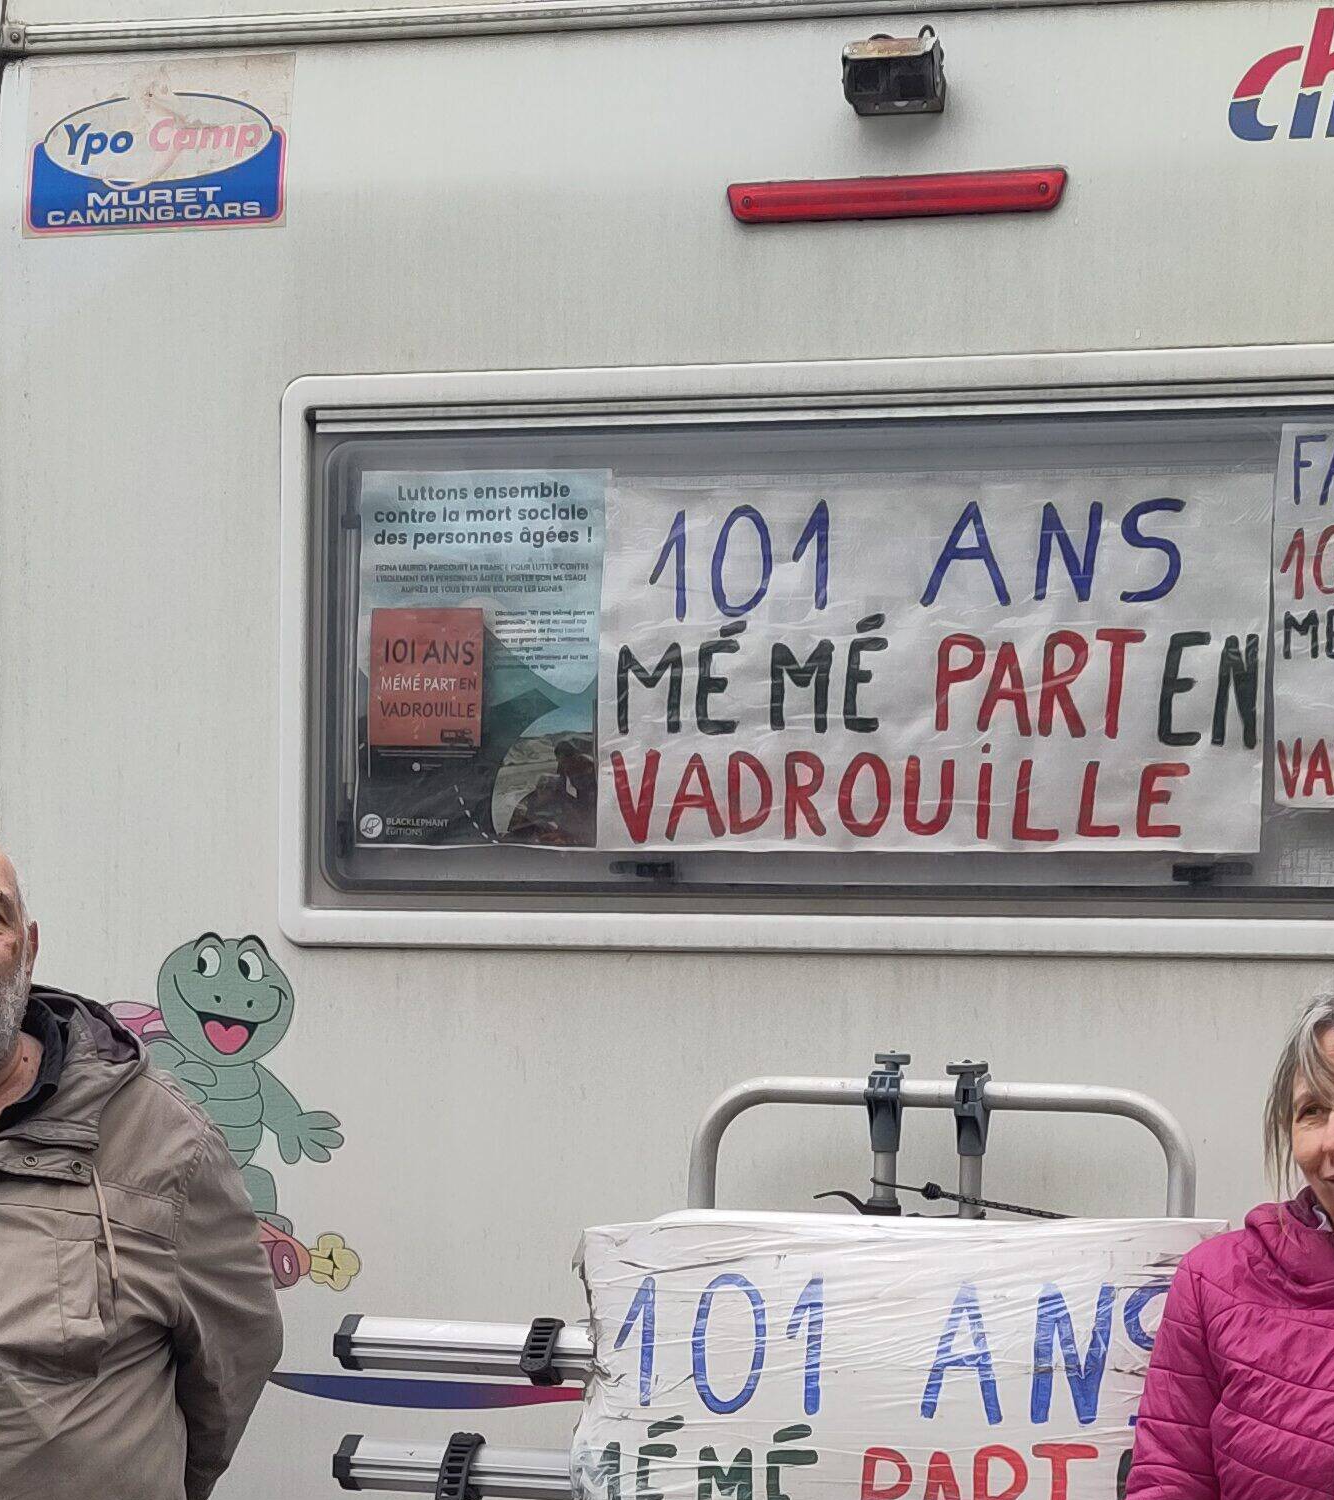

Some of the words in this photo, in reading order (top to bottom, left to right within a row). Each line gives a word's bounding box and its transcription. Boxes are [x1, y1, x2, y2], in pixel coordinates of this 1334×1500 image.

[64, 122, 134, 165] Ypo
[149, 117, 264, 157] Camp
[87, 186, 221, 207] MURET
[47, 202, 261, 226] CAMPING-CARS
[397, 485, 468, 502] Luttons
[473, 481, 571, 499] ensemble
[373, 506, 437, 524] contre
[442, 507, 460, 523] la
[466, 505, 512, 522] mort
[517, 503, 589, 521] sociale
[373, 529, 408, 546] des
[412, 530, 514, 550] personnes
[519, 526, 579, 548] âgées
[587, 526, 593, 543] !
[648, 498, 830, 622] 101
[919, 498, 1187, 607] ANS
[422, 641, 475, 666] ANS
[380, 672, 421, 692] MÉMÉ
[423, 676, 456, 691] PART
[459, 677, 477, 690] EN
[934, 629, 1147, 739] PART
[1158, 630, 1259, 749] EN
[381, 701, 476, 719] VADROUILLE
[613, 1273, 824, 1415] 101
